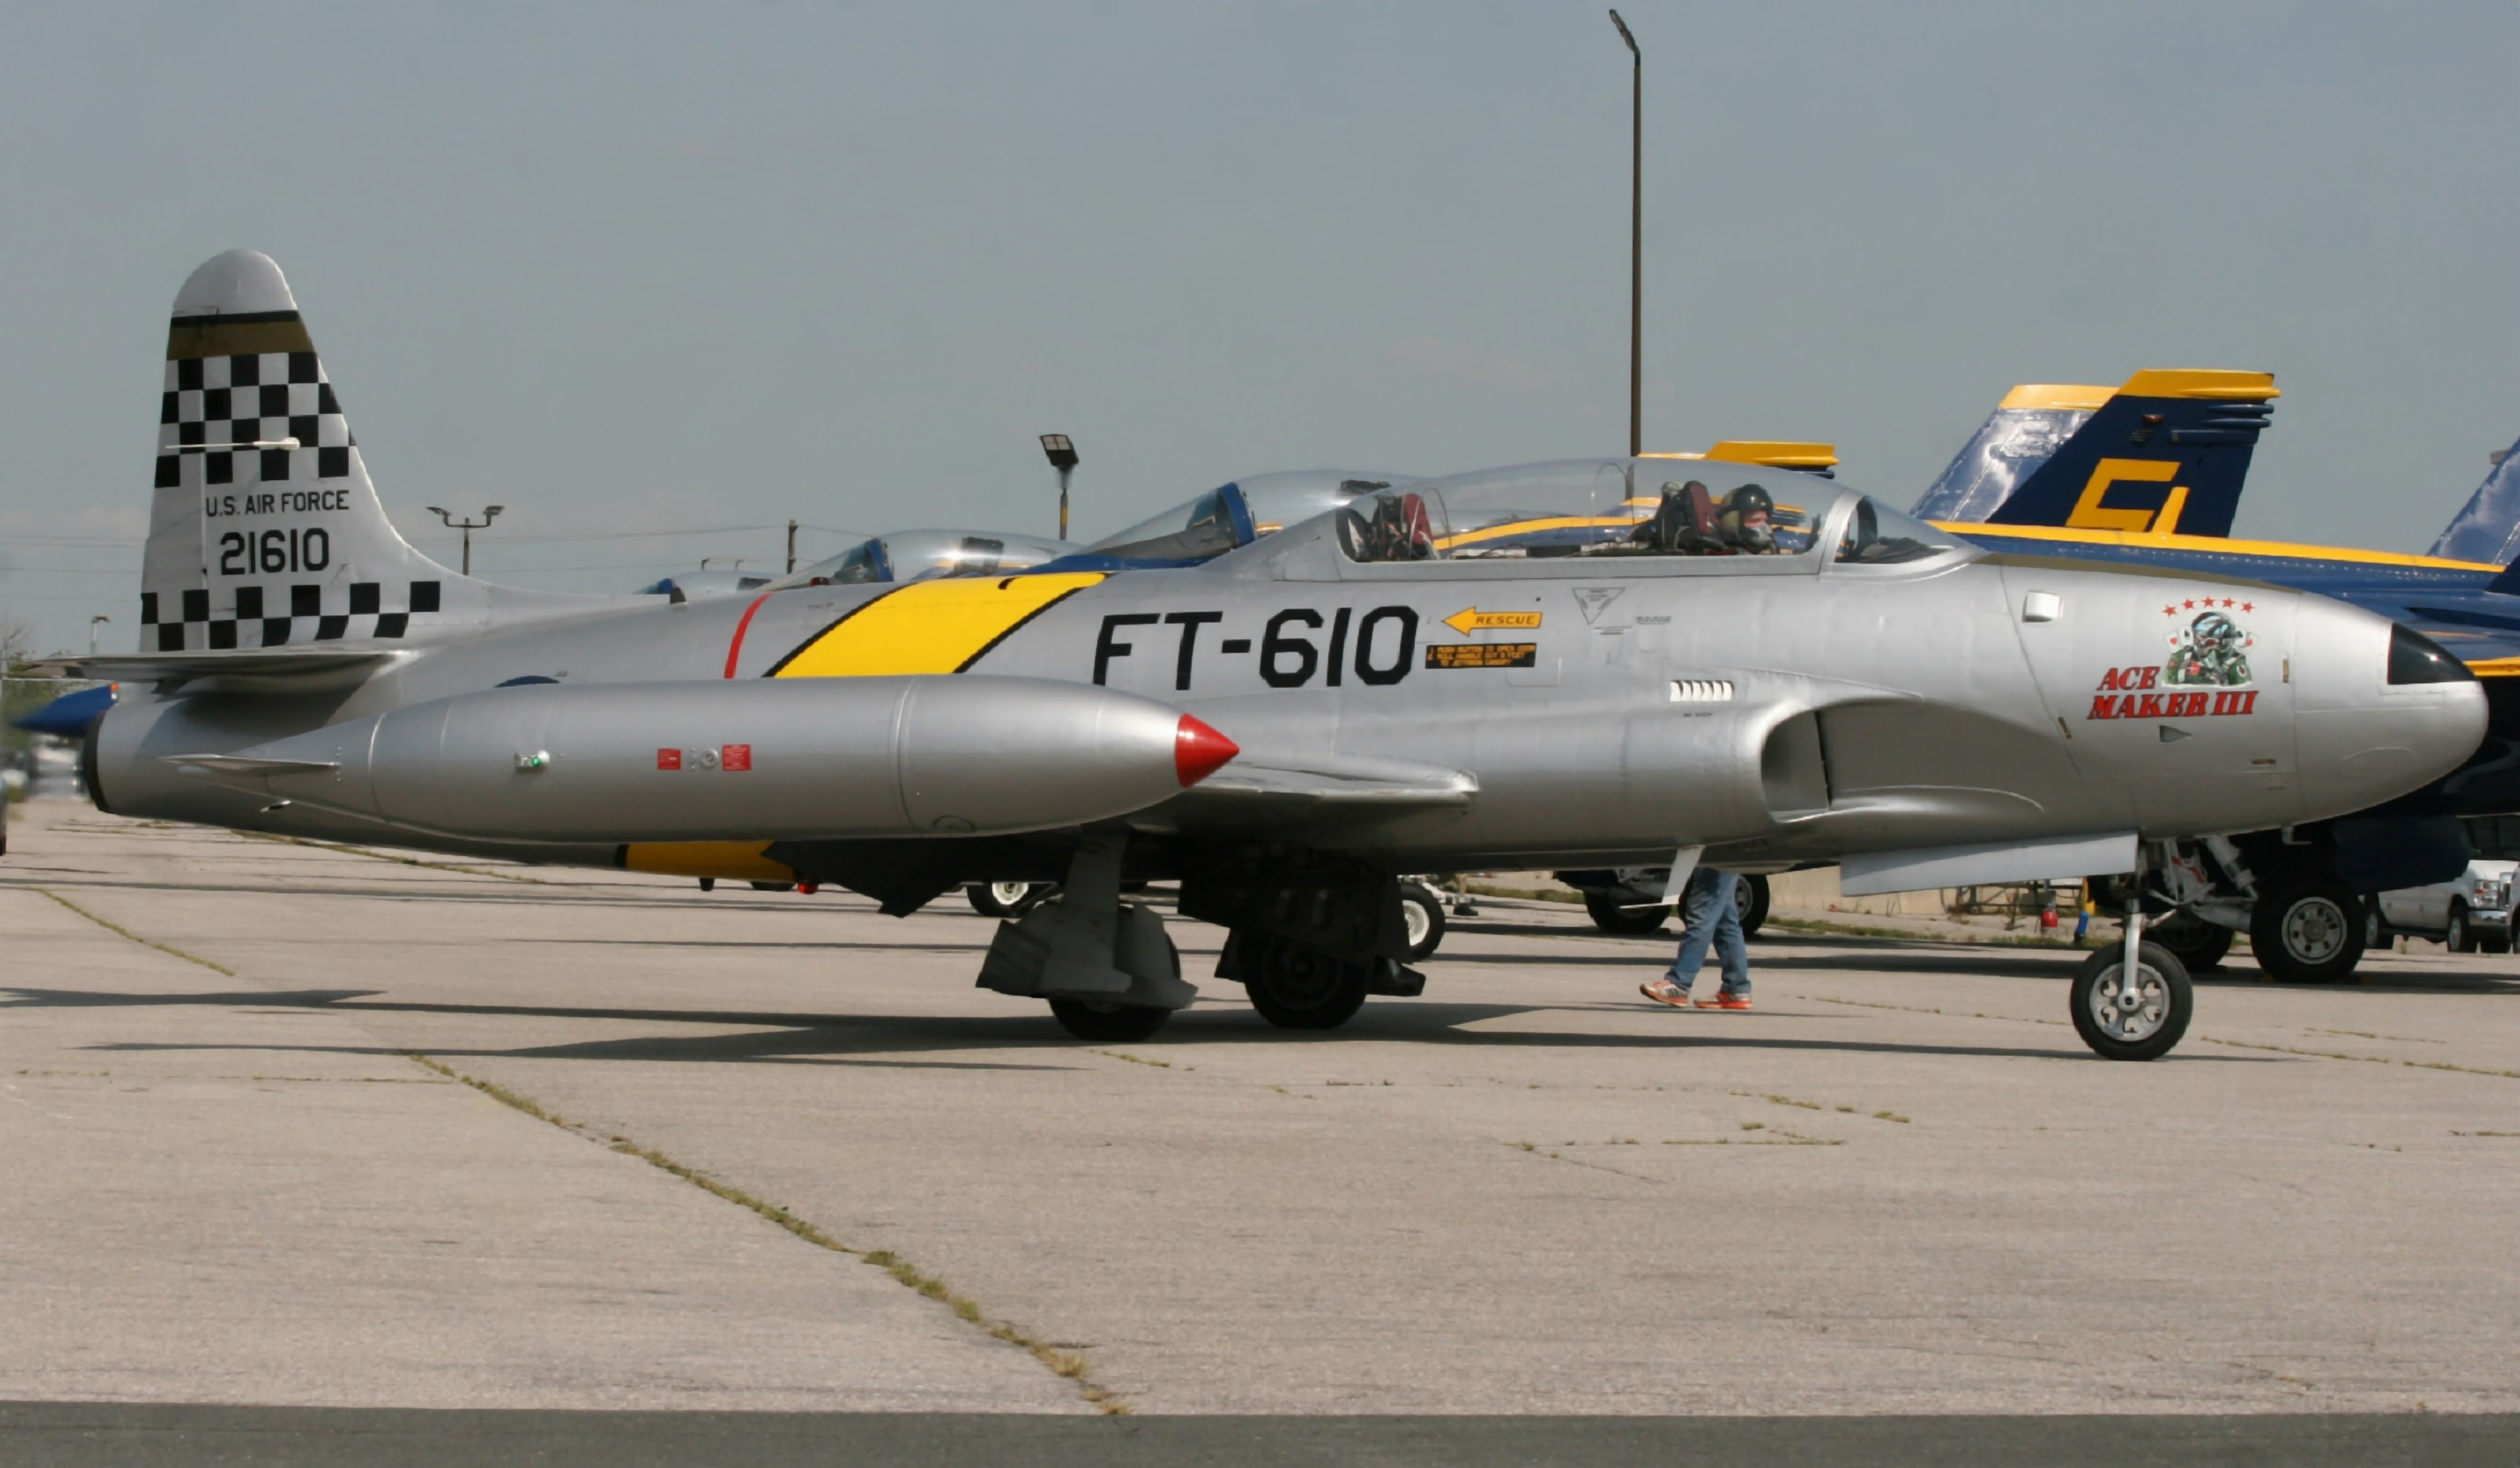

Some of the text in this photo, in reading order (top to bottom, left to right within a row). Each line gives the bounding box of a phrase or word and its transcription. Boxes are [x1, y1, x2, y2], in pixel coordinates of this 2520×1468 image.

[206, 490, 350, 517] U.S. AIR FORCE
[220, 528, 329, 575] 21610
[1475, 616, 1535, 625] RESCUE
[1092, 605, 1419, 691] FT-610
[2097, 667, 2160, 690] ACE
[2087, 691, 2258, 719] MAKER III
